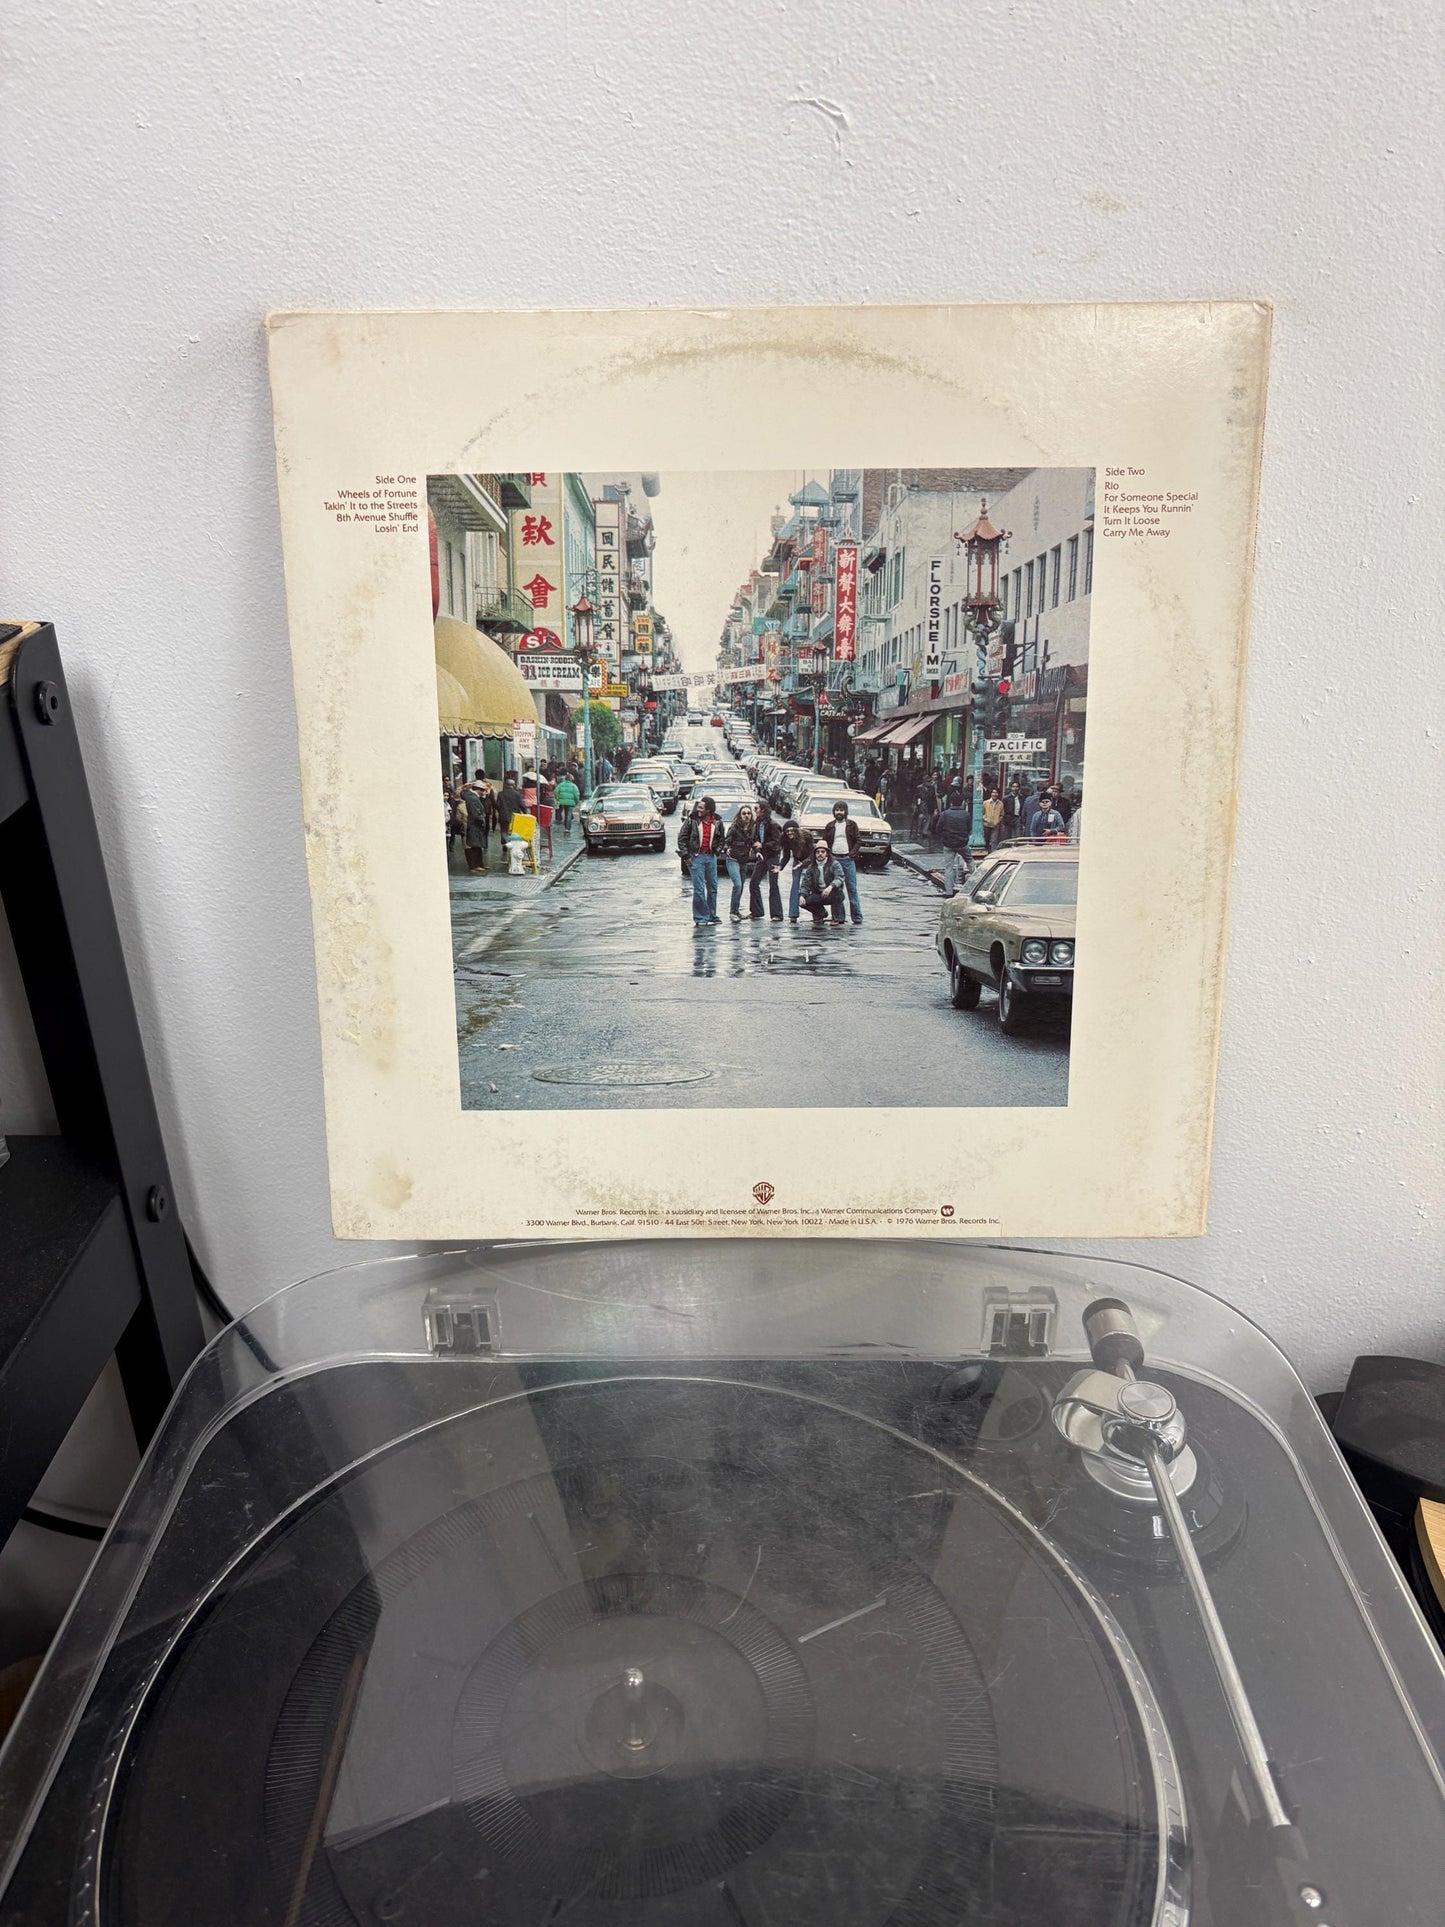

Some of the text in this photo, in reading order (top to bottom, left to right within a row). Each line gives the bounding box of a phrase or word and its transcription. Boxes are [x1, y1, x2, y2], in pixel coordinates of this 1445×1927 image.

[1105, 467, 1145, 476] Side Two
[376, 475, 416, 484] Side One
[1105, 482, 1119, 490] Rio
[337, 490, 370, 498] Wheels
[1105, 492, 1198, 502] For Someone Special
[324, 502, 347, 511] Takin'
[387, 501, 418, 509] Streets
[1113, 505, 1140, 515] Keeps
[1143, 505, 1158, 513] You
[1161, 504, 1194, 512] Runnin'
[337, 513, 351, 522] 8th
[389, 512, 418, 521] Shuffle
[1104, 517, 1121, 525] Turn
[1134, 517, 1160, 525] Loose
[375, 524, 418, 533] Losin' End
[1103, 528, 1170, 538] Carry Me Away
[926, 560, 942, 666] FLORSHEIM
[520, 656, 580, 664] BASKIN-ROBBIN
[520, 665, 580, 680] 31 ICE CREAM
[990, 741, 1042, 750] PACIFIC
